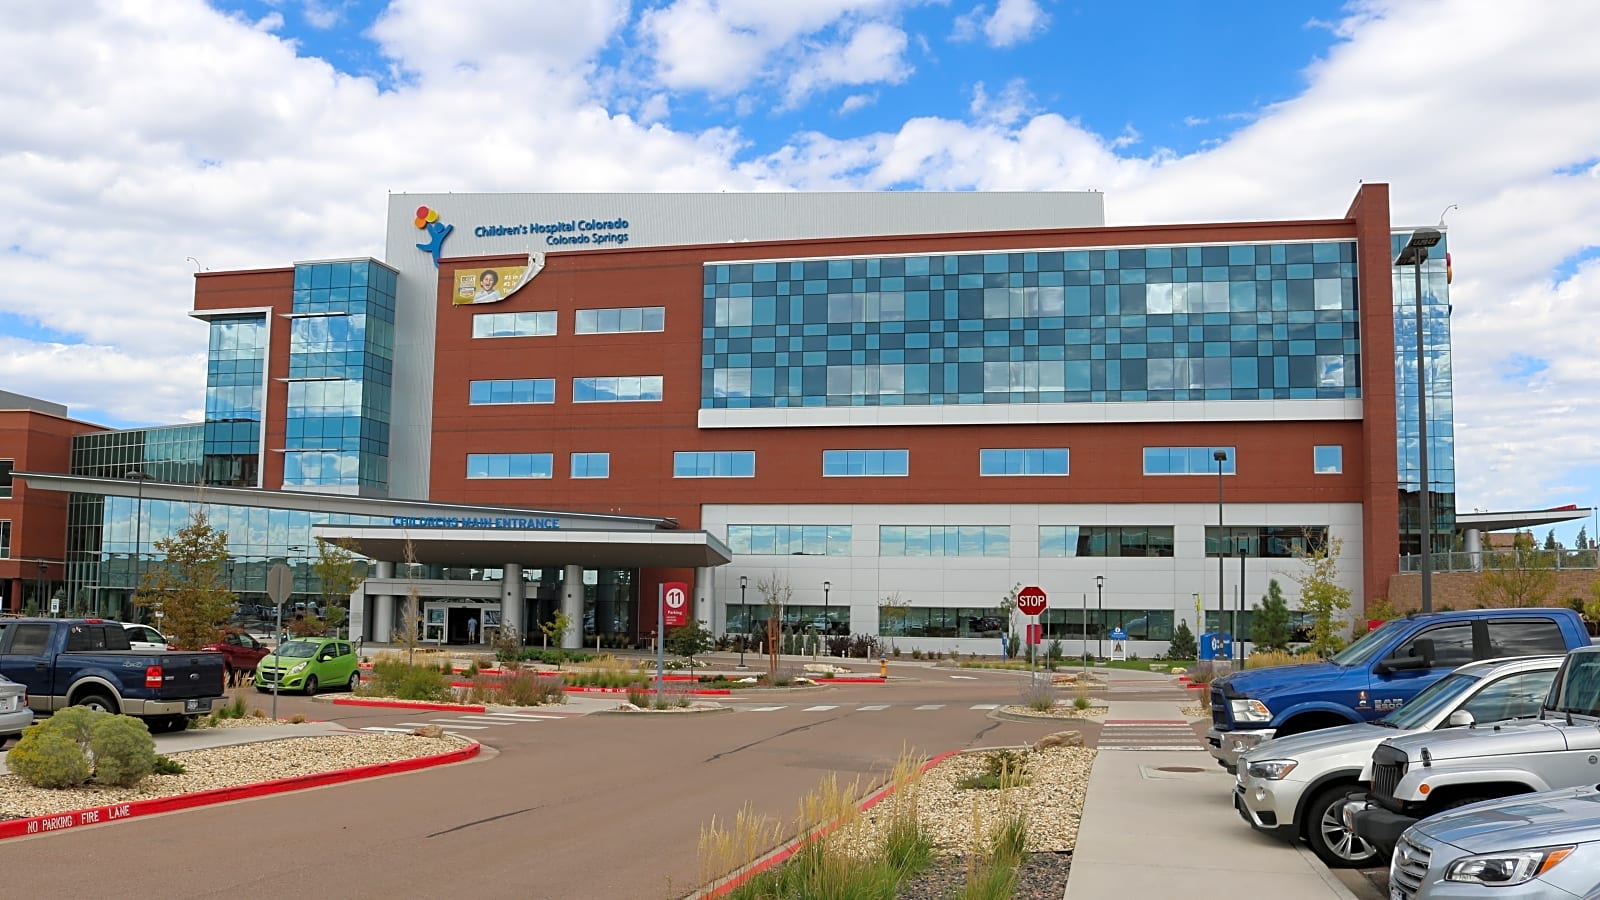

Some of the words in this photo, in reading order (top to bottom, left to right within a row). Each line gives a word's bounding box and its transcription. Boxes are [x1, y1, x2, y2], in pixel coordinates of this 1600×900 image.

[474, 224, 528, 237] Children's
[529, 220, 575, 235] Hospital
[577, 217, 629, 231] Colorado
[546, 233, 590, 246] Colorado
[591, 232, 629, 244] Springs
[461, 517, 492, 528] MAIN
[495, 517, 560, 529] ENTRANCE
[669, 591, 681, 605] 11
[1019, 595, 1045, 607] STOP
[27, 821, 38, 834] NO
[42, 816, 72, 831] PARKING
[81, 810, 99, 825] FIRE
[108, 805, 130, 819] LANE
